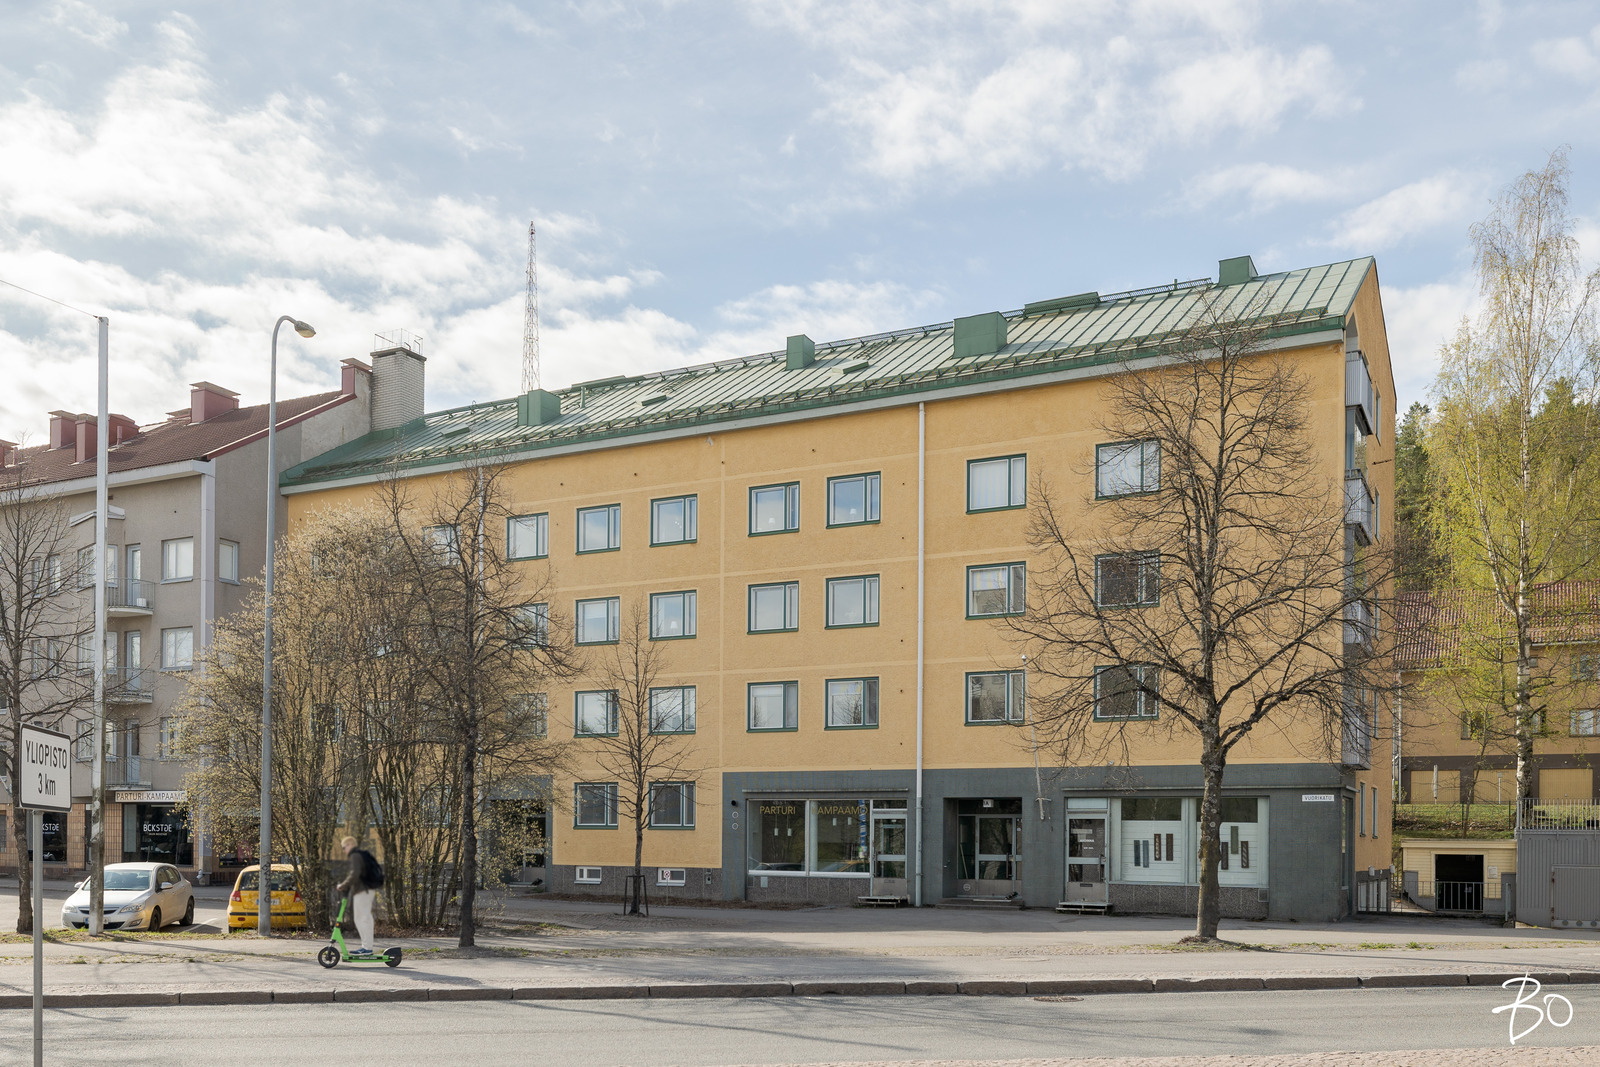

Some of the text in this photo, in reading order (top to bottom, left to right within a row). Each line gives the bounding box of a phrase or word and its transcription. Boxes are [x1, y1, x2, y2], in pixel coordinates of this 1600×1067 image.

[26, 740, 67, 769] YLIOPISTO
[38, 773, 56, 795] 3 km
[759, 805, 796, 815] PARTURI
